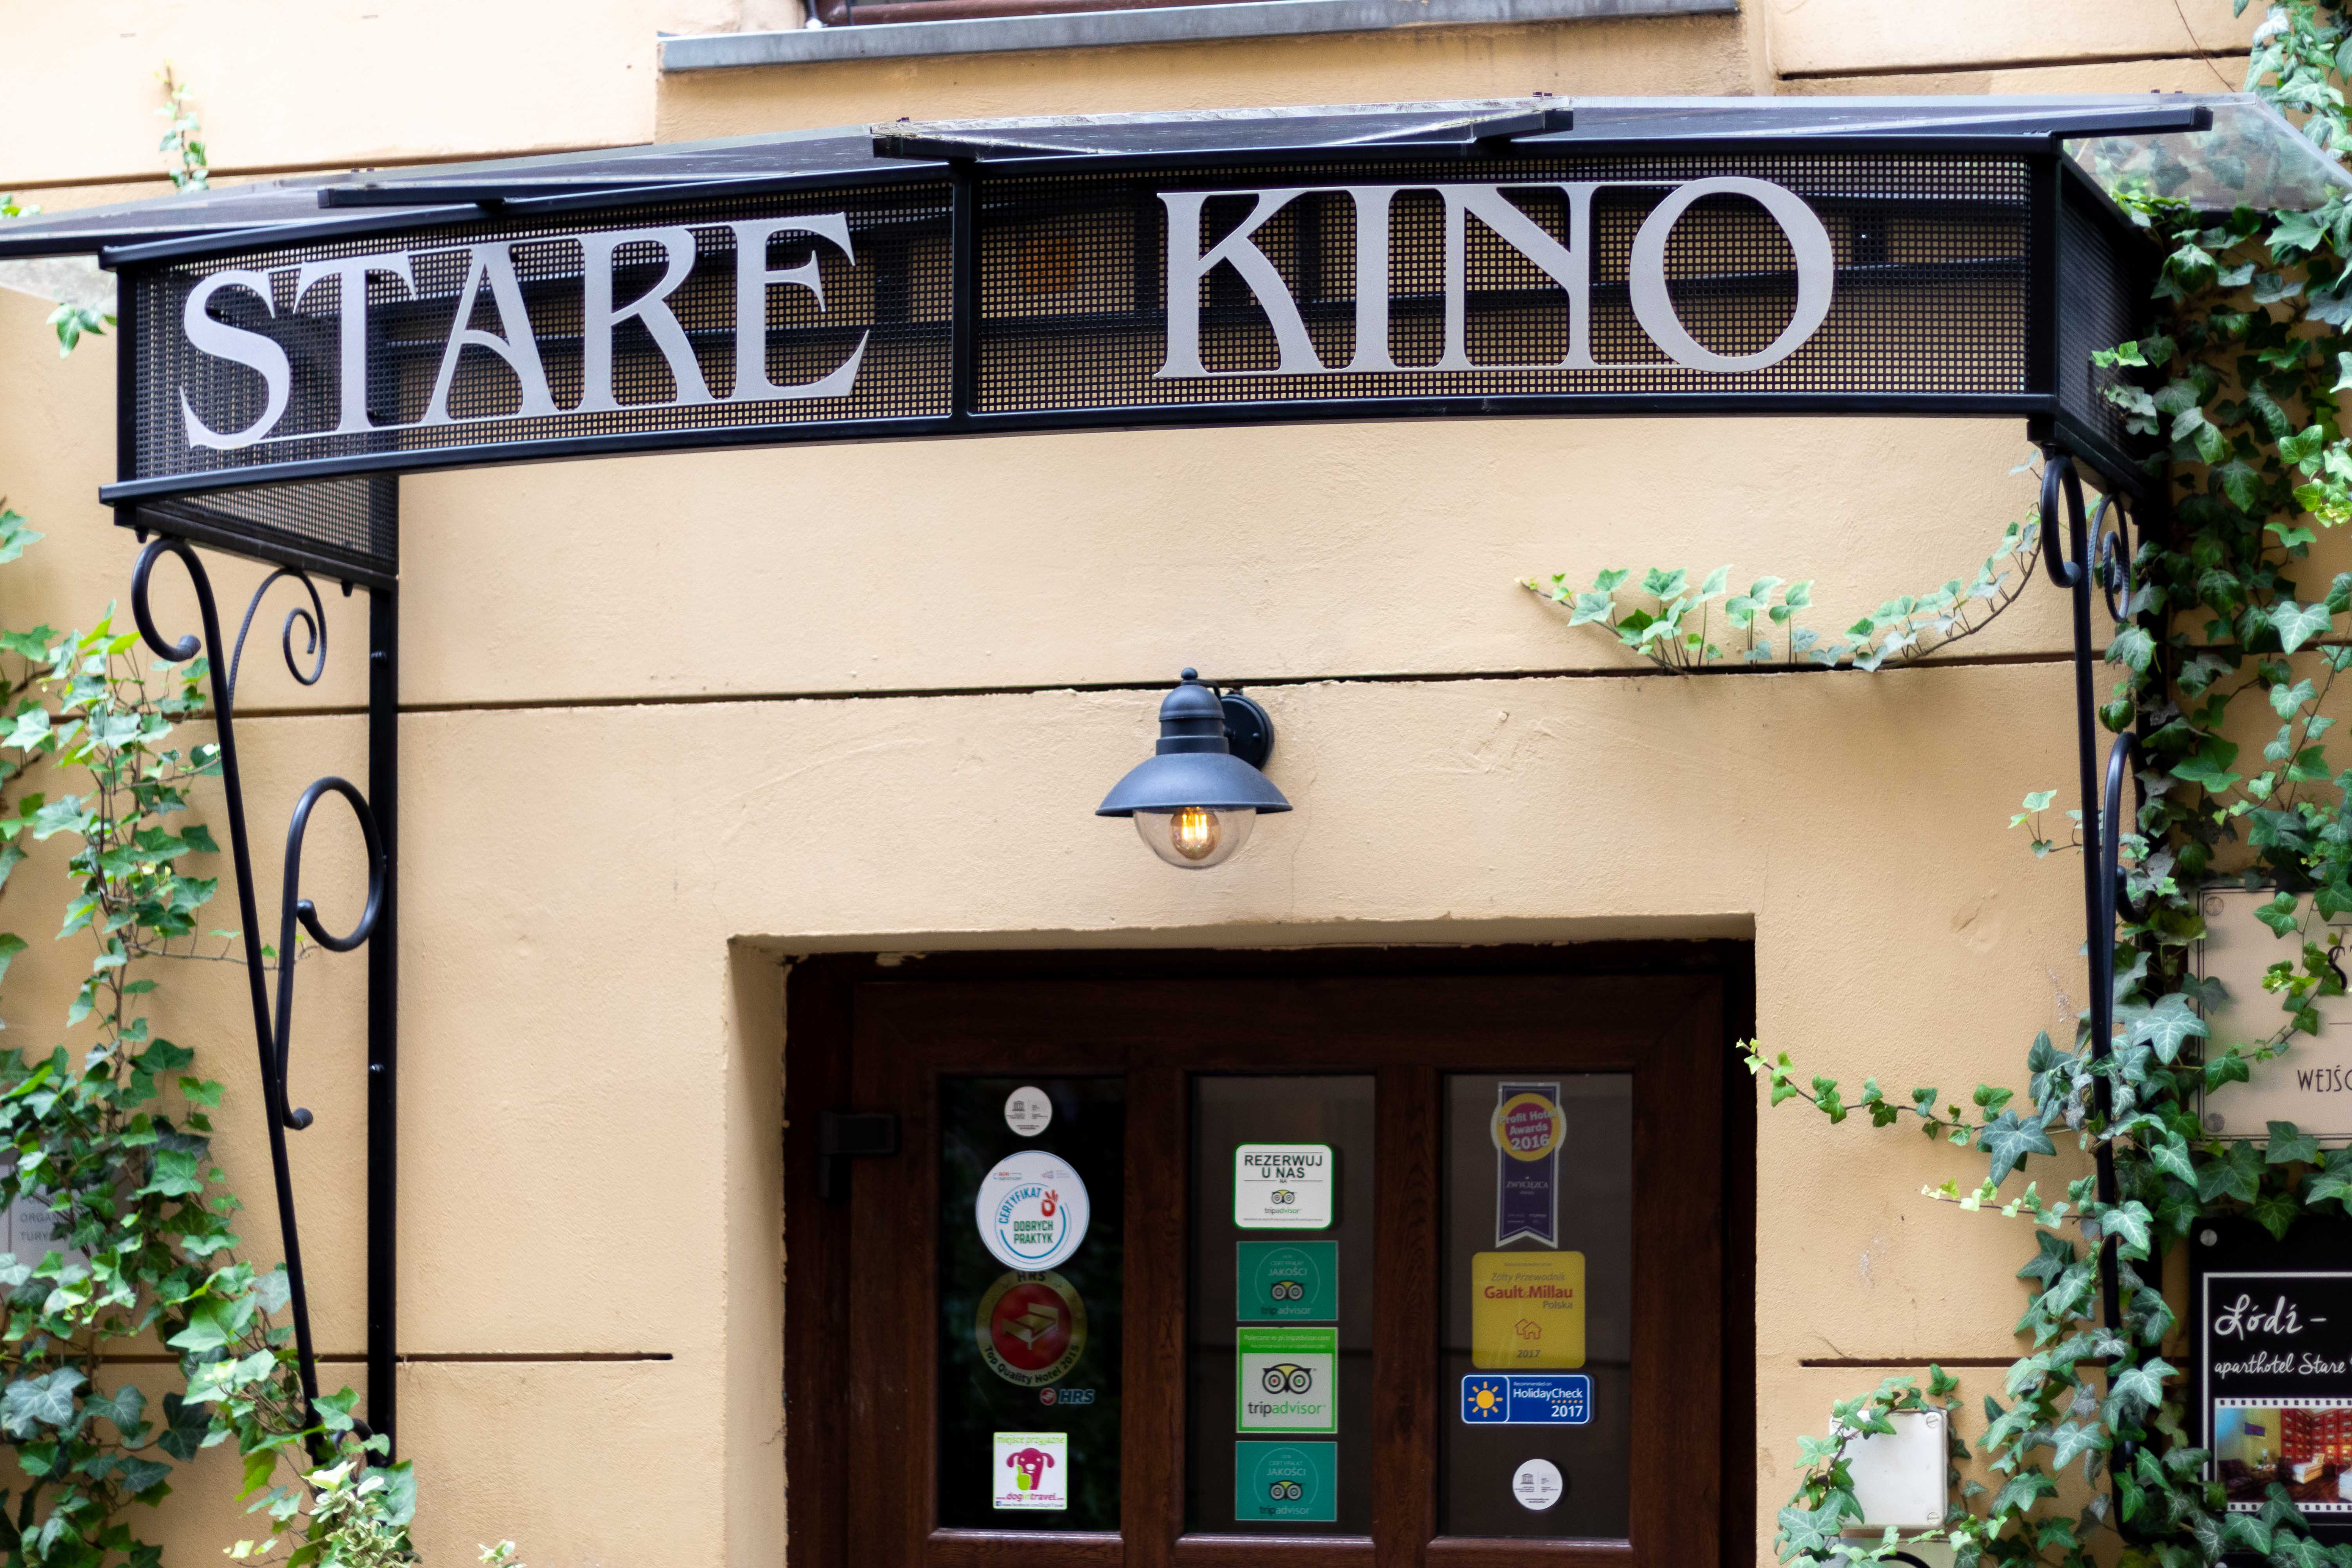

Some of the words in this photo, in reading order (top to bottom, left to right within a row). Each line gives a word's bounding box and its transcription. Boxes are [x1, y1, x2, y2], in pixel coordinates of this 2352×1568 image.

[179, 212, 870, 451] STARE
[1154, 176, 1835, 378] KINO
[1499, 1113, 1526, 1125] Profit
[1530, 1110, 1556, 1120] Hotel
[1510, 1122, 1548, 1135] Awards
[1511, 1134, 1550, 1151] 2016
[1244, 1155, 1323, 1167] REZERWUJ
[1261, 1167, 1270, 1178] U
[1276, 1167, 1305, 1178] NAS
[998, 1187, 1042, 1223] CERTYFIKAT
[1014, 1220, 1053, 1231] DOBRYCH
[1014, 1233, 1053, 1244] PRAKTYK
[1017, 1271, 1046, 1282] HRS
[1268, 1266, 1307, 1276] JAKOŚCI
[1543, 1300, 1573, 1308] Polska
[1261, 1305, 1311, 1316] tripadvisor
[1517, 1349, 1540, 1358] 2017
[985, 1345, 998, 1364] Top
[997, 1363, 1032, 1385] Quality
[1035, 1367, 1062, 1383] Hotel
[2214, 1351, 2295, 1379] aparthotel
[2298, 1352, 2346, 1374] Stare
[1058, 1389, 1095, 1404] HRS
[1513, 1388, 1583, 1401] HolidayCheck
[1248, 1401, 1322, 1417] tripadvisor
[1551, 1405, 1583, 1417] 2017
[1267, 1466, 1306, 1476] JAKOŚCI
[1259, 1505, 1310, 1516] tripadvisor
